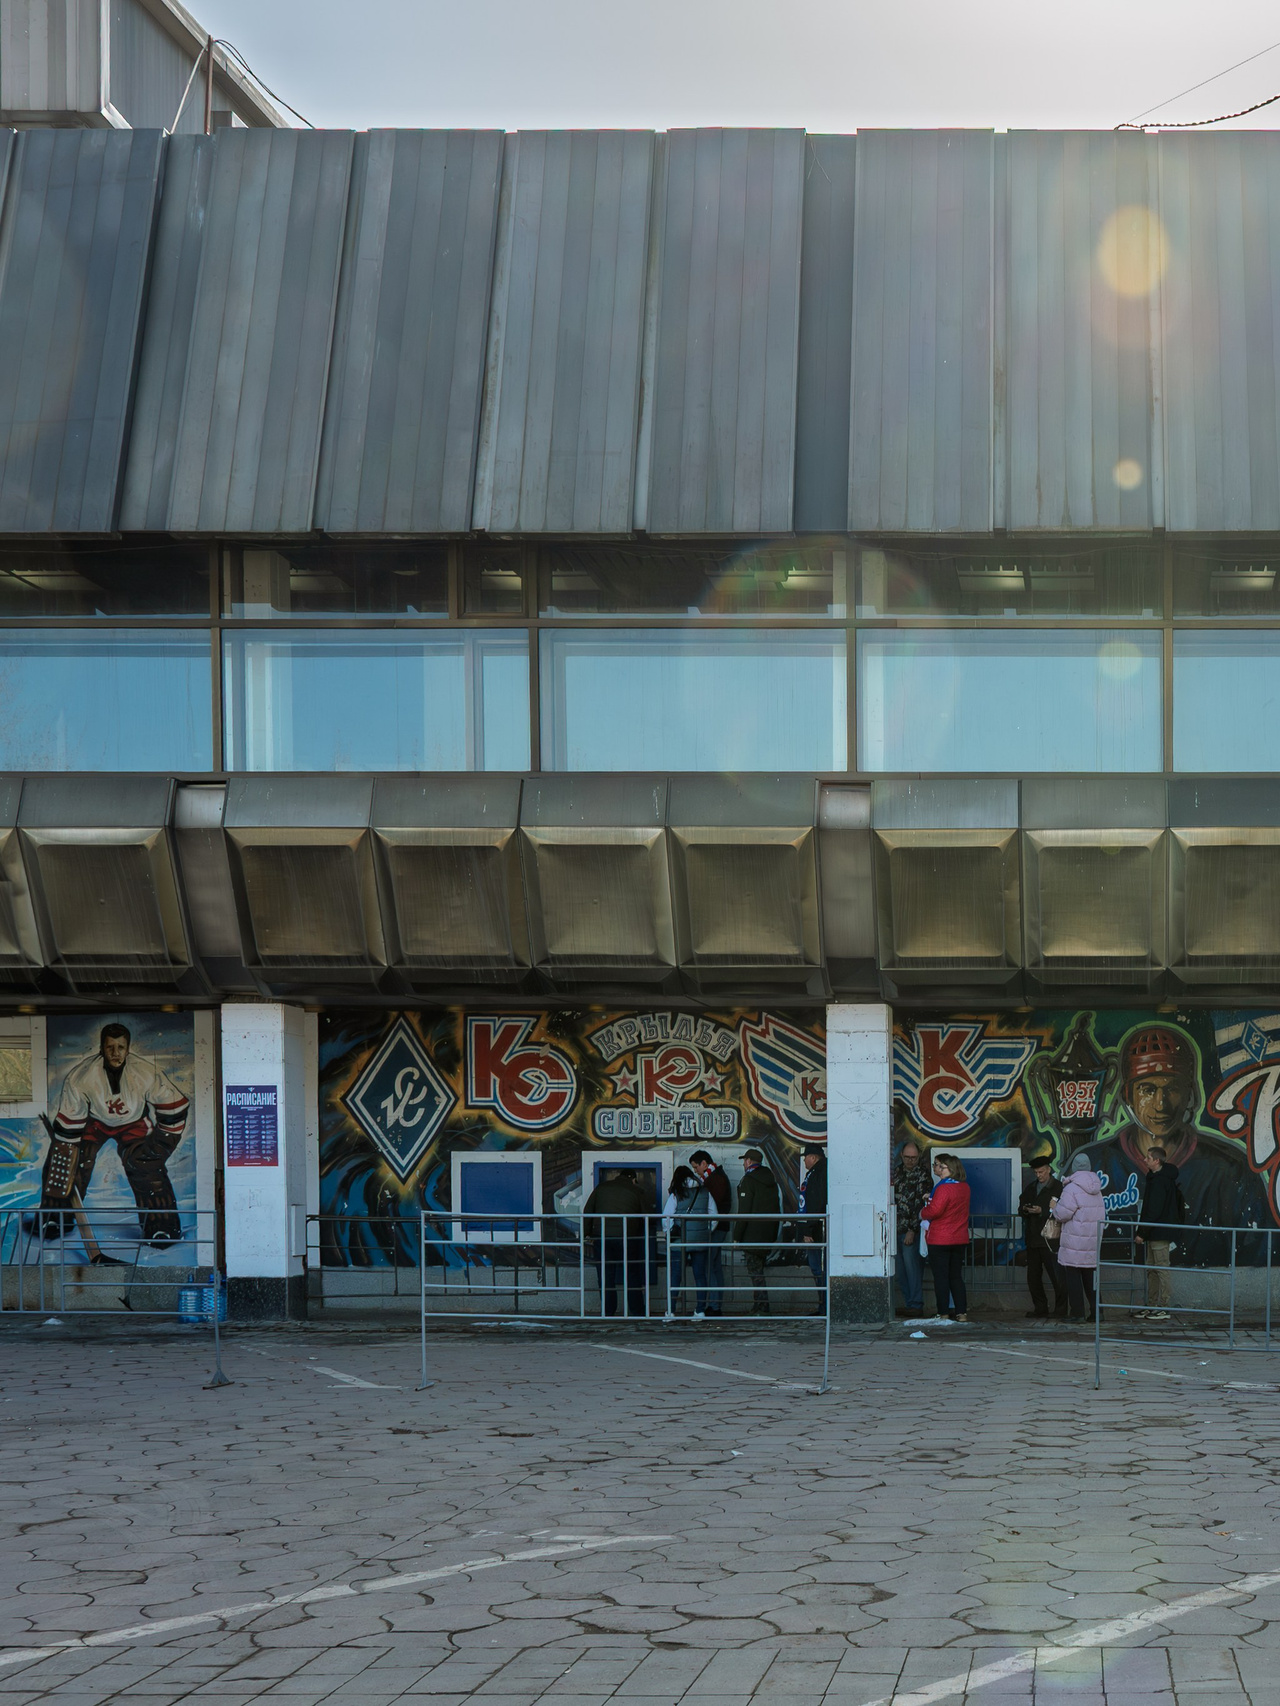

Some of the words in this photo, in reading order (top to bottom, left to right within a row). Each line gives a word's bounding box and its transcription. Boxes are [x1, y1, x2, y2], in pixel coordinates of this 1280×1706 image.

[595, 1013, 738, 1060] КРЫЛЬЯ
[226, 1092, 277, 1106] РАСПИСАНИЕ
[1057, 1080, 1098, 1100] 1957
[1059, 1099, 1096, 1119] 1974
[599, 1110, 737, 1135] СОВЕТОВ
